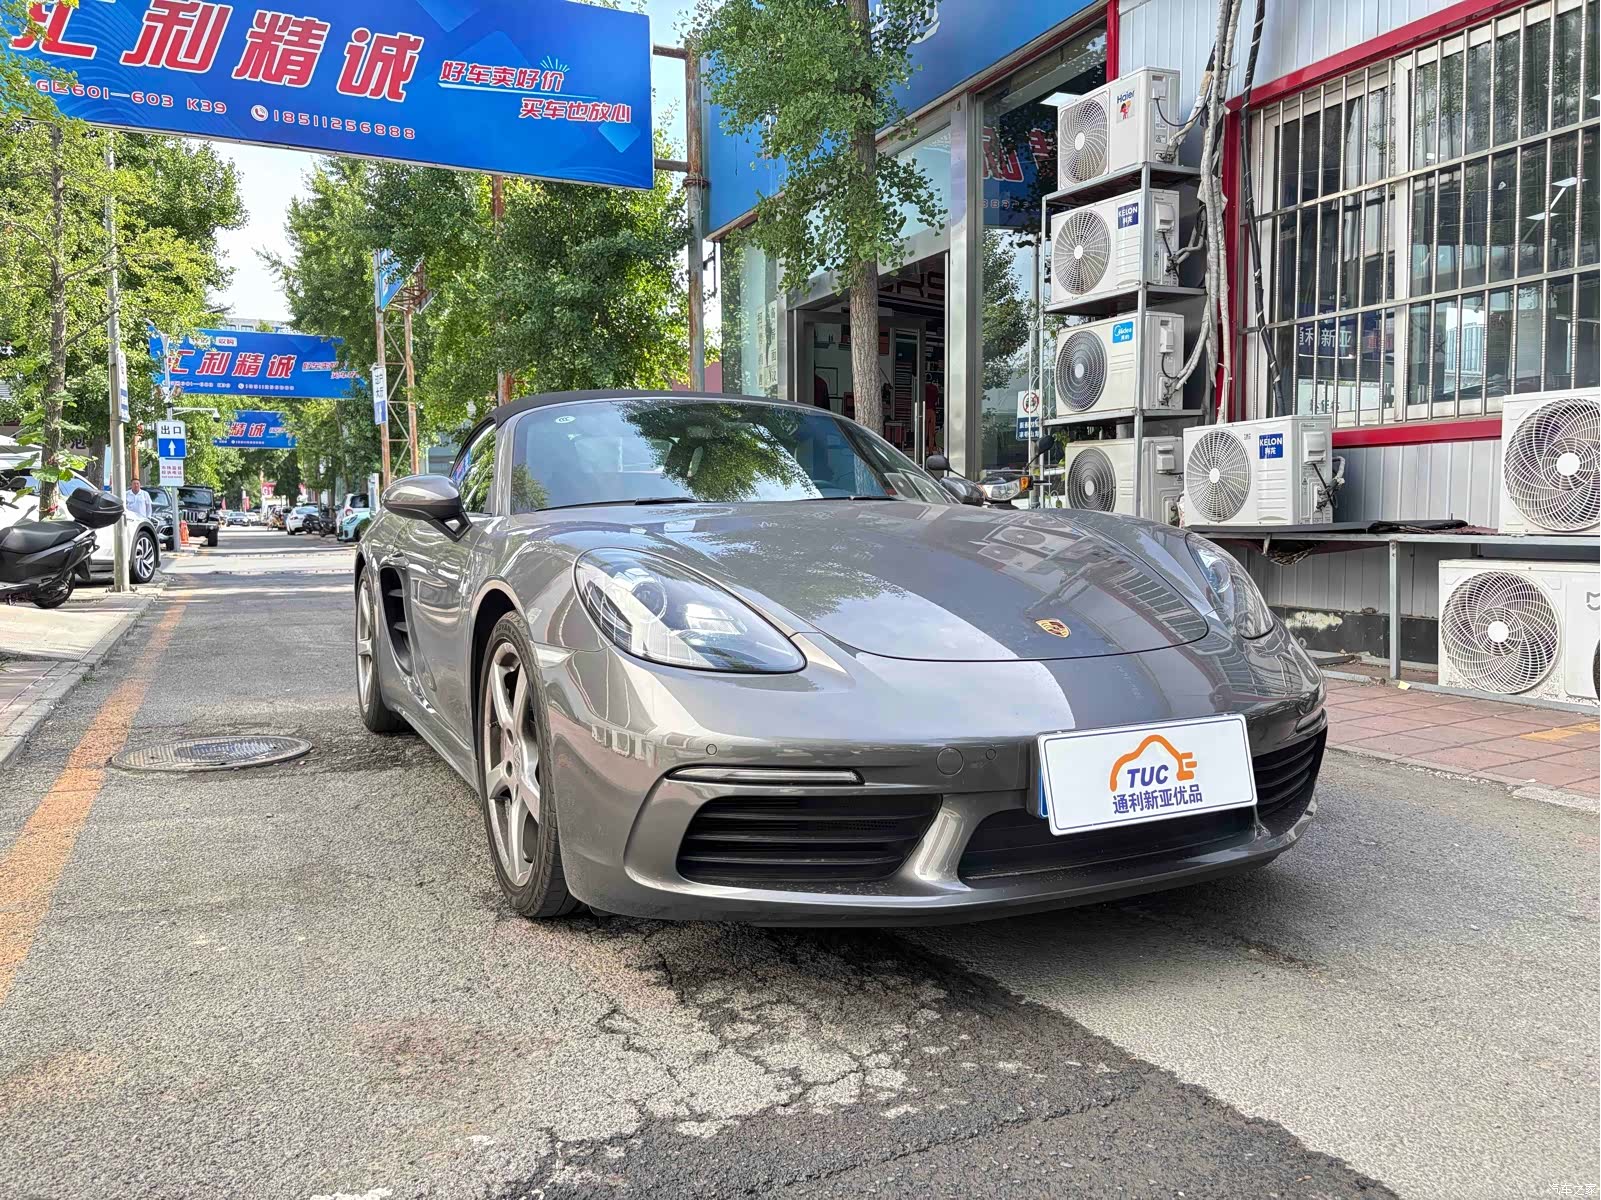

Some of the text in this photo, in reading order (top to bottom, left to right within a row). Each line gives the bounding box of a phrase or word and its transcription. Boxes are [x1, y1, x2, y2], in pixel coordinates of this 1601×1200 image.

[439, 60, 565, 91] 好车卖好价
[186, 97, 227, 114] K39
[1117, 90, 1135, 104] Haier
[518, 98, 632, 123] 买车也放心
[273, 110, 416, 139] 18511256888
[1299, 327, 1352, 348] 利新亚
[161, 425, 182, 435] 出口
[1259, 437, 1283, 447] KELON
[1112, 784, 1203, 814] 通利新亚优品
